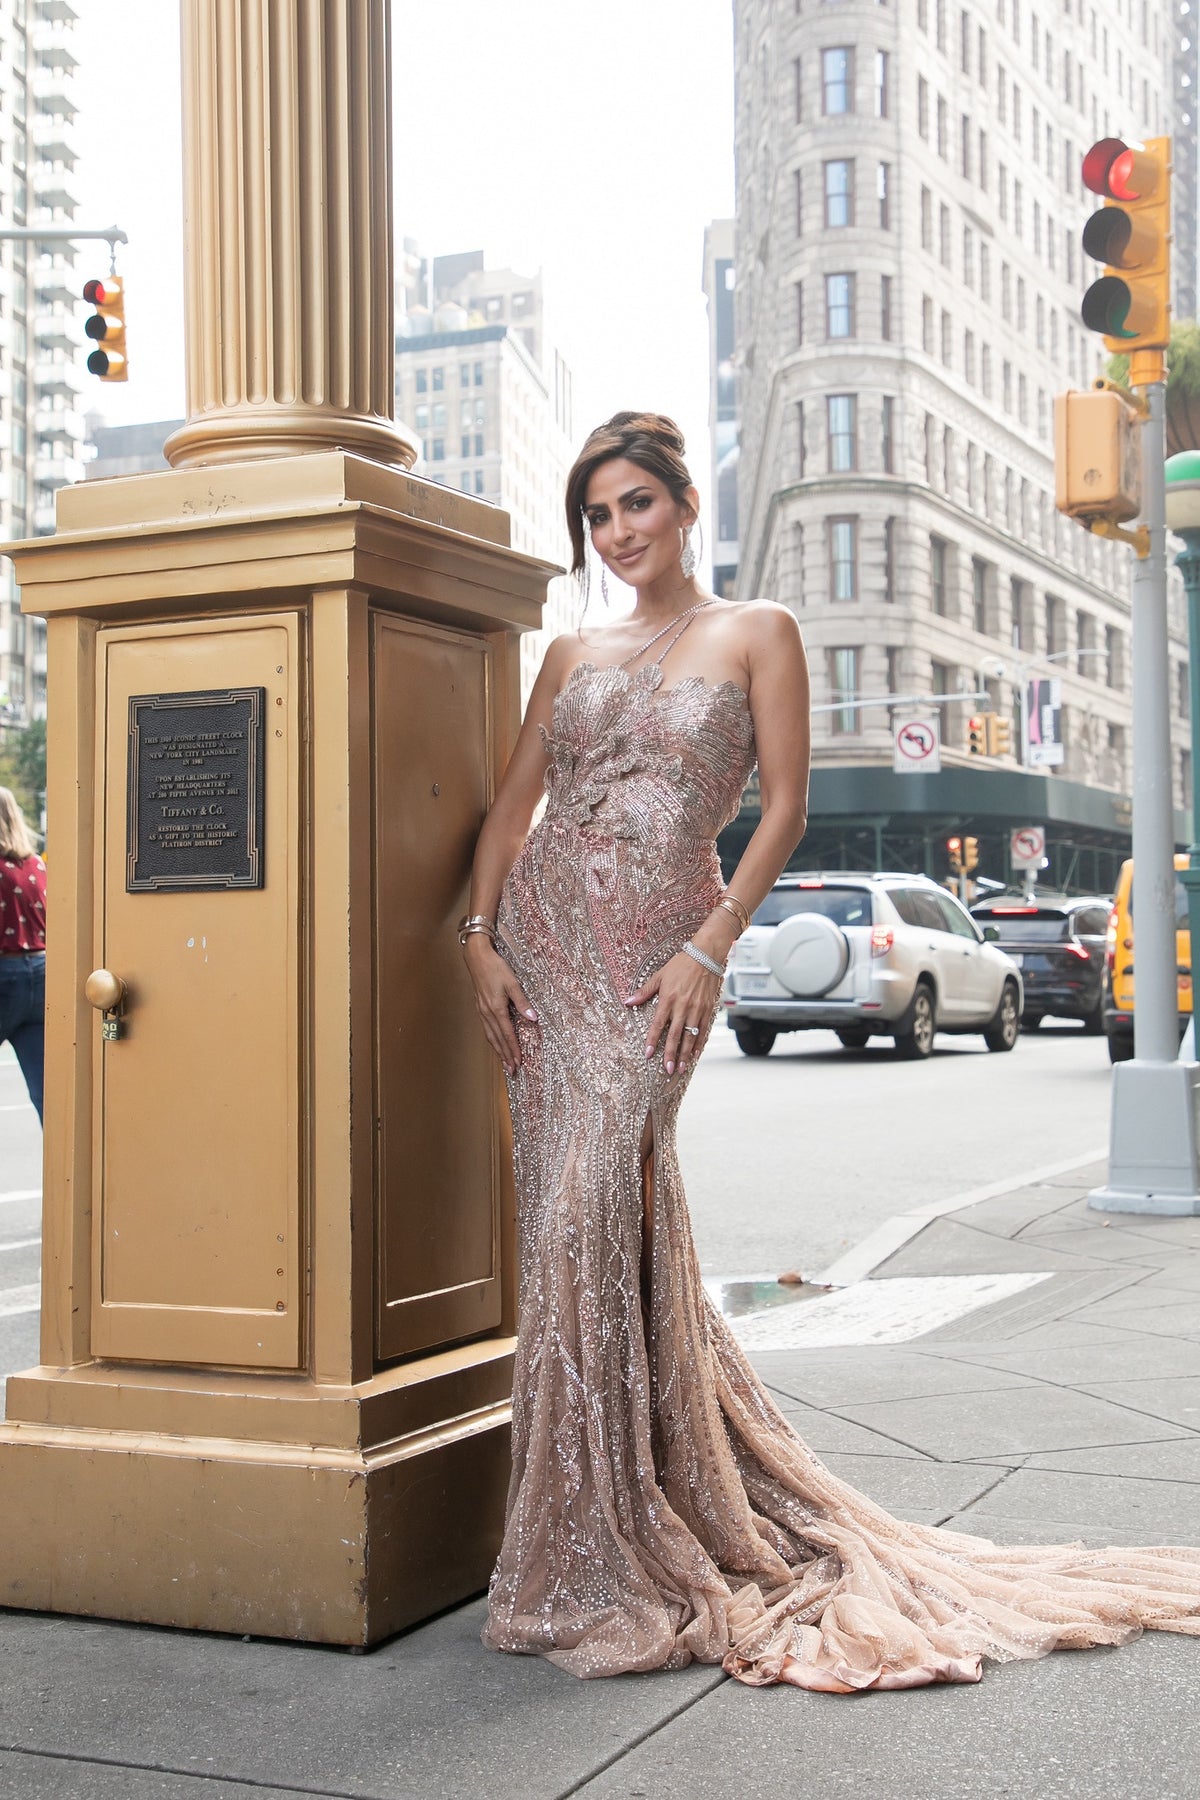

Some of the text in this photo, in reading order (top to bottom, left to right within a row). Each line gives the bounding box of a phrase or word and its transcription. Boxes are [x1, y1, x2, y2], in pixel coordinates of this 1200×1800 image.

[198, 733, 220, 741] STREET
[178, 741, 217, 750] DESIGNATED
[202, 748, 237, 756] LANDMARK
[175, 773, 219, 782] ESTABLISHING
[176, 781, 226, 790] HEADQUARTERS
[200, 806, 207, 816] &
